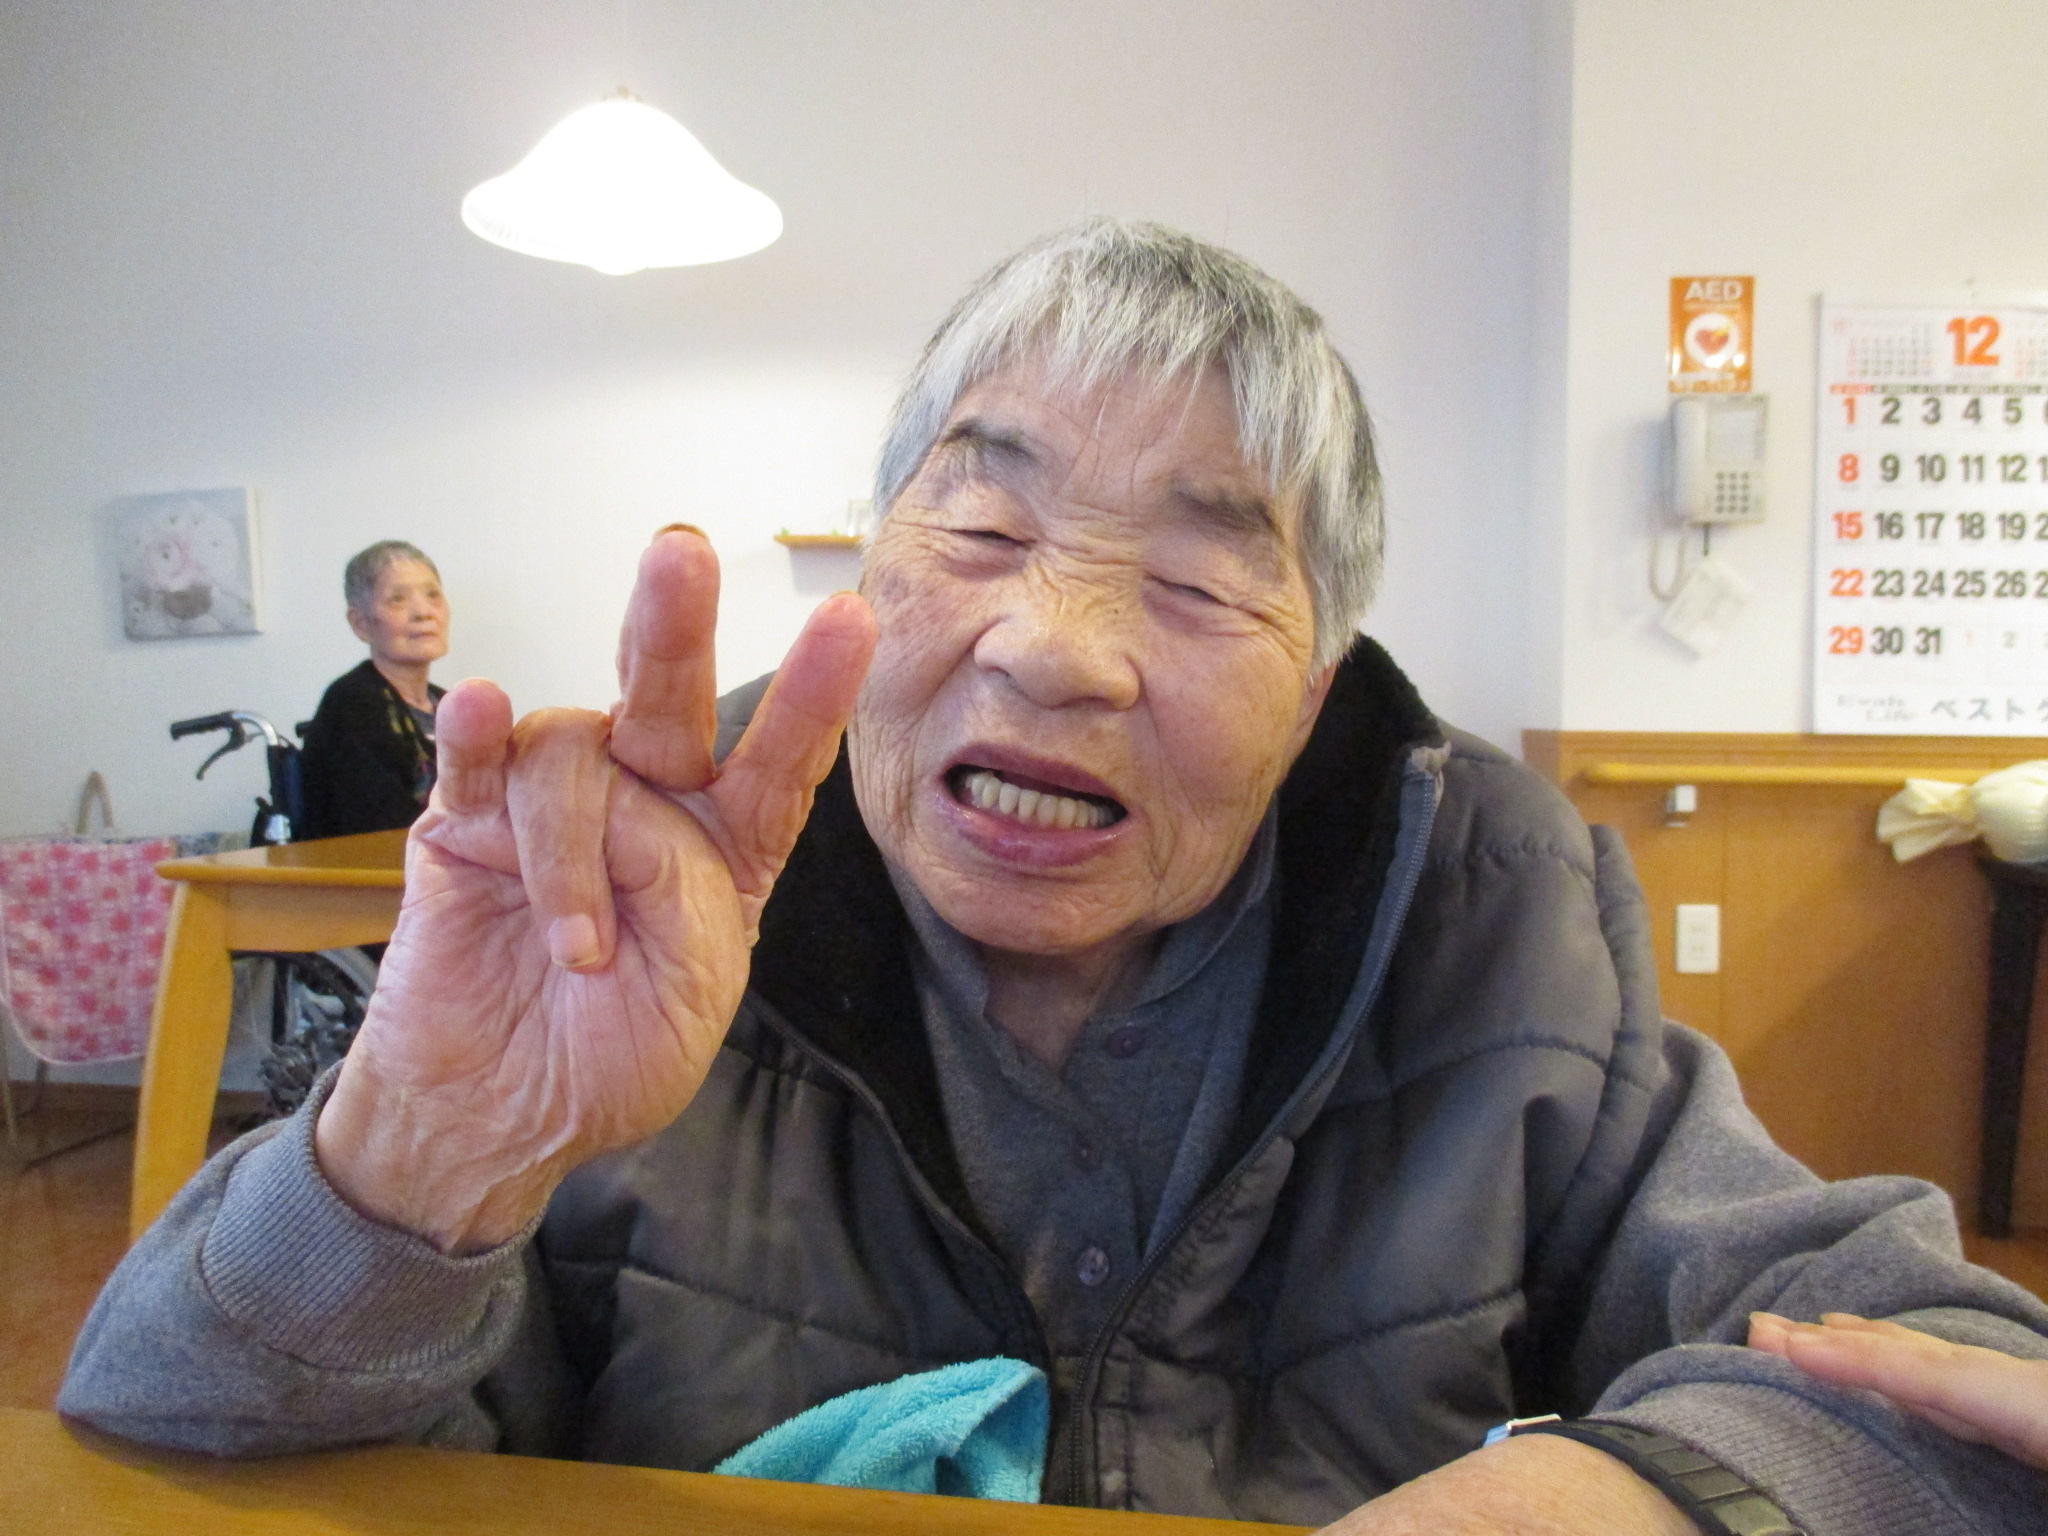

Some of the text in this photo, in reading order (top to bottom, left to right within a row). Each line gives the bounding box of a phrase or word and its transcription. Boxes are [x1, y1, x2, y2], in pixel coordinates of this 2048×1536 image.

[1684, 280, 1744, 301] AED
[1946, 316, 2000, 366] 12
[1844, 397, 1856, 424] 1
[1881, 397, 1901, 424] 2
[1922, 397, 1941, 424] 3
[1963, 398, 1982, 424] 4
[2004, 398, 2022, 425] 5
[1838, 453, 1859, 482] 8
[1880, 454, 1900, 482] 9
[1916, 455, 1946, 482] 10
[1959, 455, 1984, 482] 11
[1998, 455, 2027, 482] 12
[1833, 512, 1863, 540] 15
[1875, 512, 1904, 540] 16
[1915, 512, 1944, 539] 17
[1957, 512, 1985, 540] 18
[1997, 512, 2026, 540] 19
[1830, 569, 1863, 597] 22
[1872, 569, 1904, 597] 23
[1913, 570, 1945, 597] 24
[1953, 570, 1985, 598] 25
[1993, 570, 2026, 598] 26
[1829, 626, 1863, 655] 29
[1871, 627, 1903, 655] 30
[1915, 627, 1941, 655] 31
